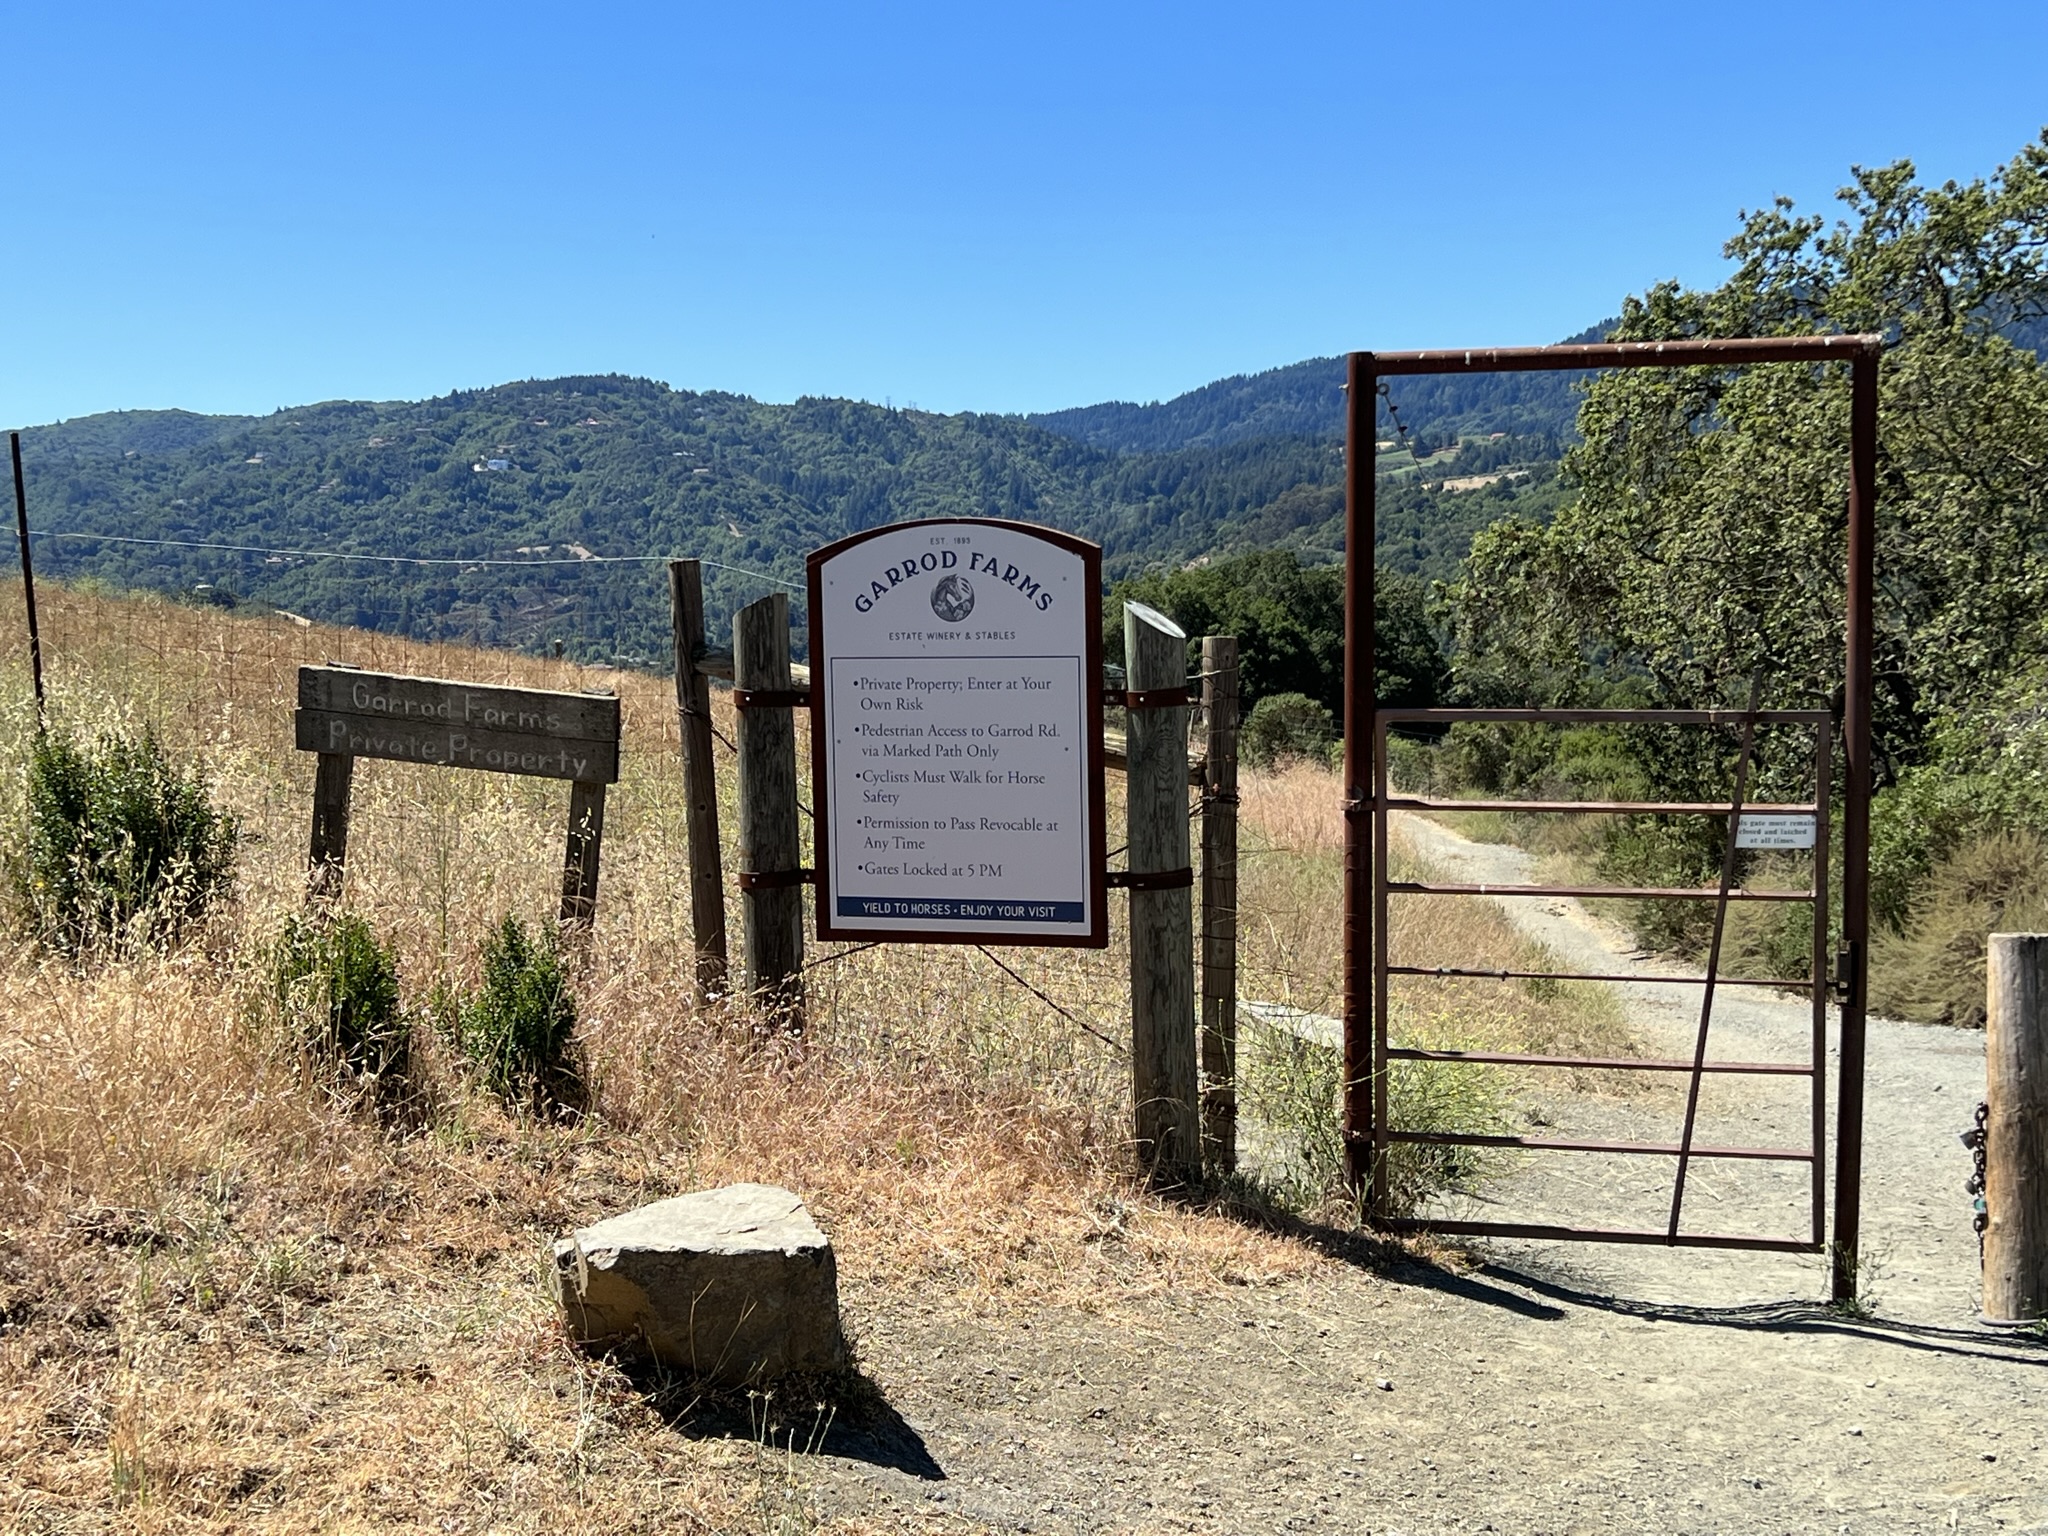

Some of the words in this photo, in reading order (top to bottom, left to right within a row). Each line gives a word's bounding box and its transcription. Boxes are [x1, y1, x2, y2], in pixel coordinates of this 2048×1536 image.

[854, 550, 958, 614] GARROD
[969, 552, 1054, 612] FARMS
[889, 632, 923, 640] ESTATE
[926, 632, 961, 640] WINERY
[964, 632, 972, 640] &
[976, 632, 1016, 640] STABLES
[860, 677, 902, 691] Private
[906, 677, 964, 693] Property;
[967, 677, 1002, 690] Enter
[1006, 679, 1018, 690] at
[1020, 677, 1052, 690] Your
[352, 681, 451, 719] Garrod
[464, 692, 561, 731] Farms
[860, 698, 892, 711] Own
[896, 698, 924, 711] Risk
[861, 724, 924, 738] Pedestrian
[927, 724, 967, 737] Access
[971, 727, 984, 737] to
[988, 724, 1034, 738] Garrod
[1038, 724, 1061, 738] Rd.
[329, 719, 436, 760] Private
[450, 733, 587, 778] Property
[862, 746, 880, 757] via
[883, 744, 931, 757] Marked
[935, 744, 963, 758] Path
[967, 744, 999, 761] Only
[862, 770, 910, 786] Cyclists
[913, 771, 946, 783] Must
[949, 770, 982, 784] Walk
[985, 771, 1003, 784] for
[1008, 771, 1045, 784] Horse
[862, 790, 900, 806] Safety
[863, 816, 929, 830] Permission
[934, 819, 946, 830] to
[950, 817, 976, 831] Pass
[979, 818, 1043, 832] Revocable
[1046, 821, 1058, 832] at
[864, 836, 888, 852] Any
[892, 836, 925, 850] Time
[864, 862, 899, 875] Gates
[903, 863, 948, 877] Locked
[951, 866, 964, 877] at
[967, 864, 975, 877] 5
[979, 864, 1002, 877] PM
[862, 902, 891, 914] YIELD
[894, 903, 908, 914] TO
[911, 903, 951, 915] HORSES
[960, 905, 993, 916] ENJOY
[996, 906, 1025, 917] YOUR
[1028, 906, 1056, 918] VISIT
